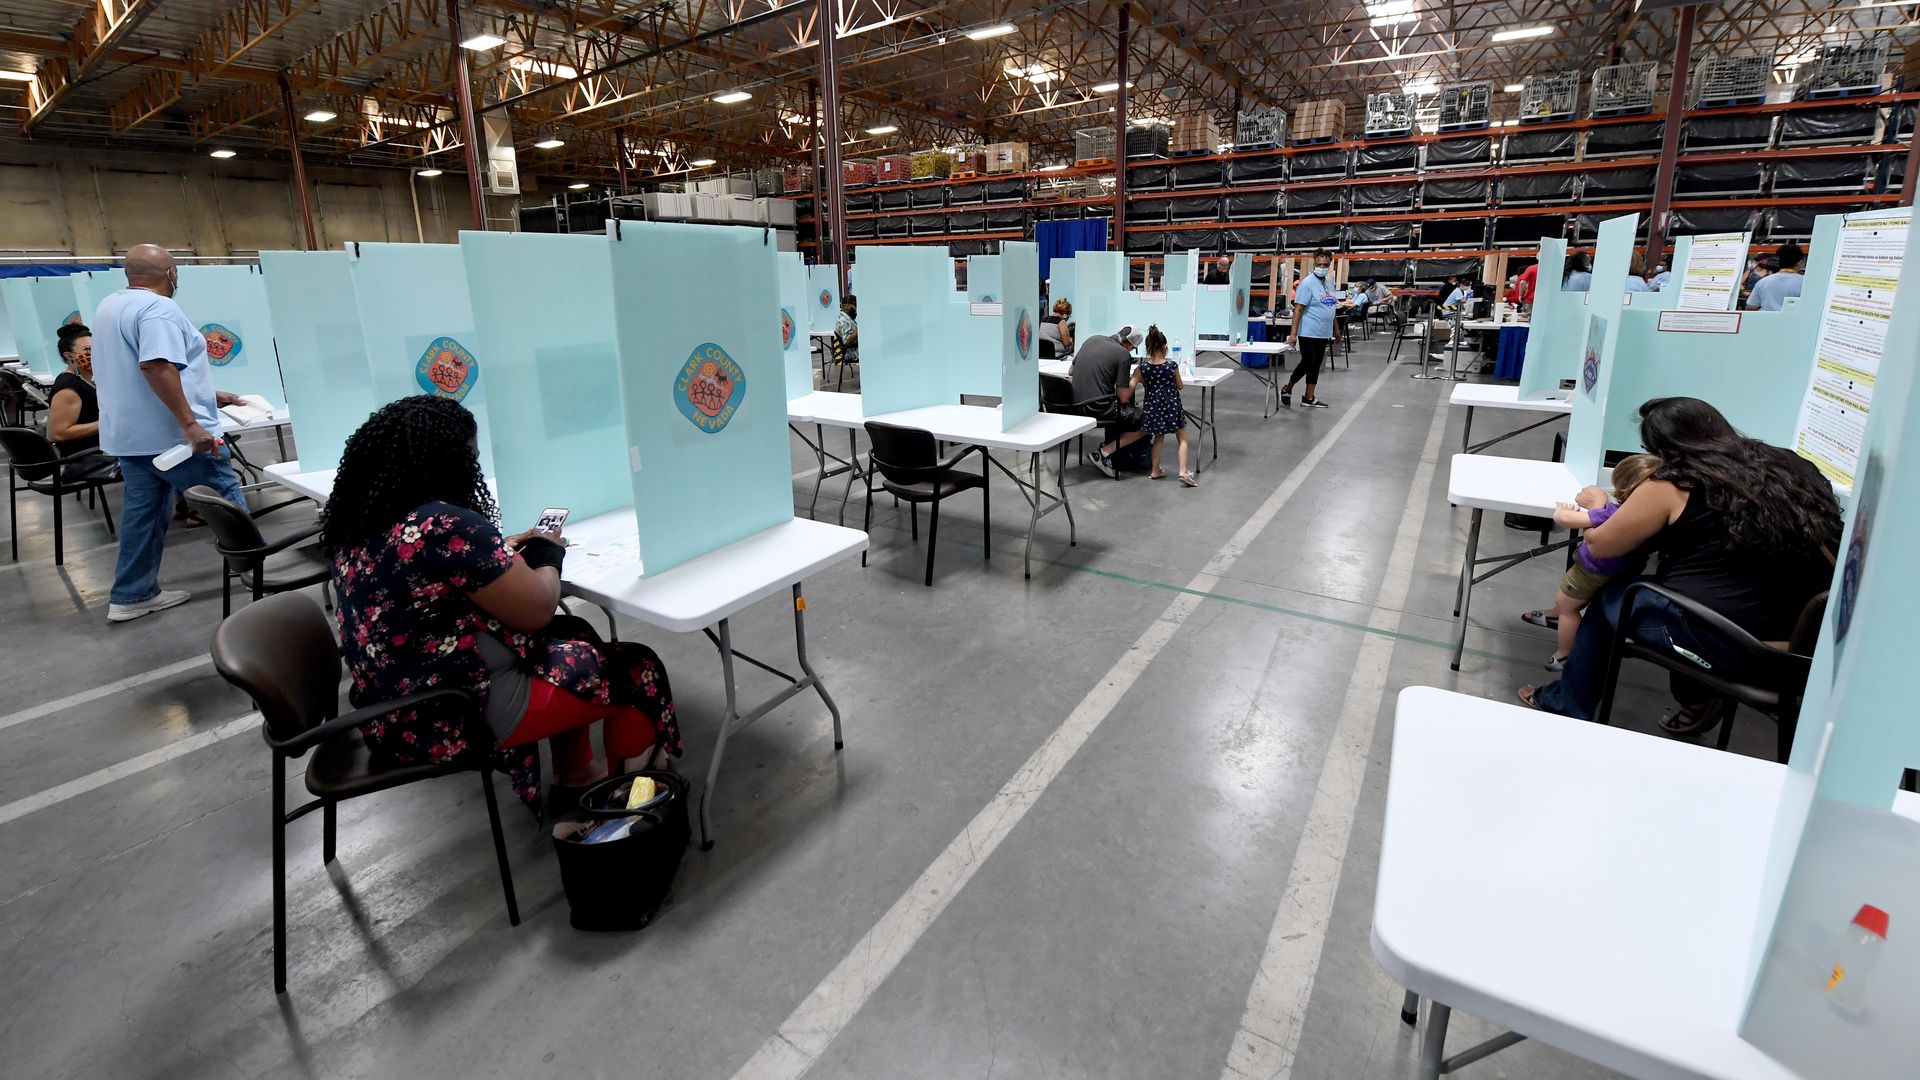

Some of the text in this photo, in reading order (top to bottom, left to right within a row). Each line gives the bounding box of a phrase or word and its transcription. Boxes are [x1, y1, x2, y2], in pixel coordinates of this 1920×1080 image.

[419, 340, 476, 374] CLARK COUNTY
[677, 347, 743, 393] CLARK COUNTY
[692, 404, 734, 430] NEVADA
